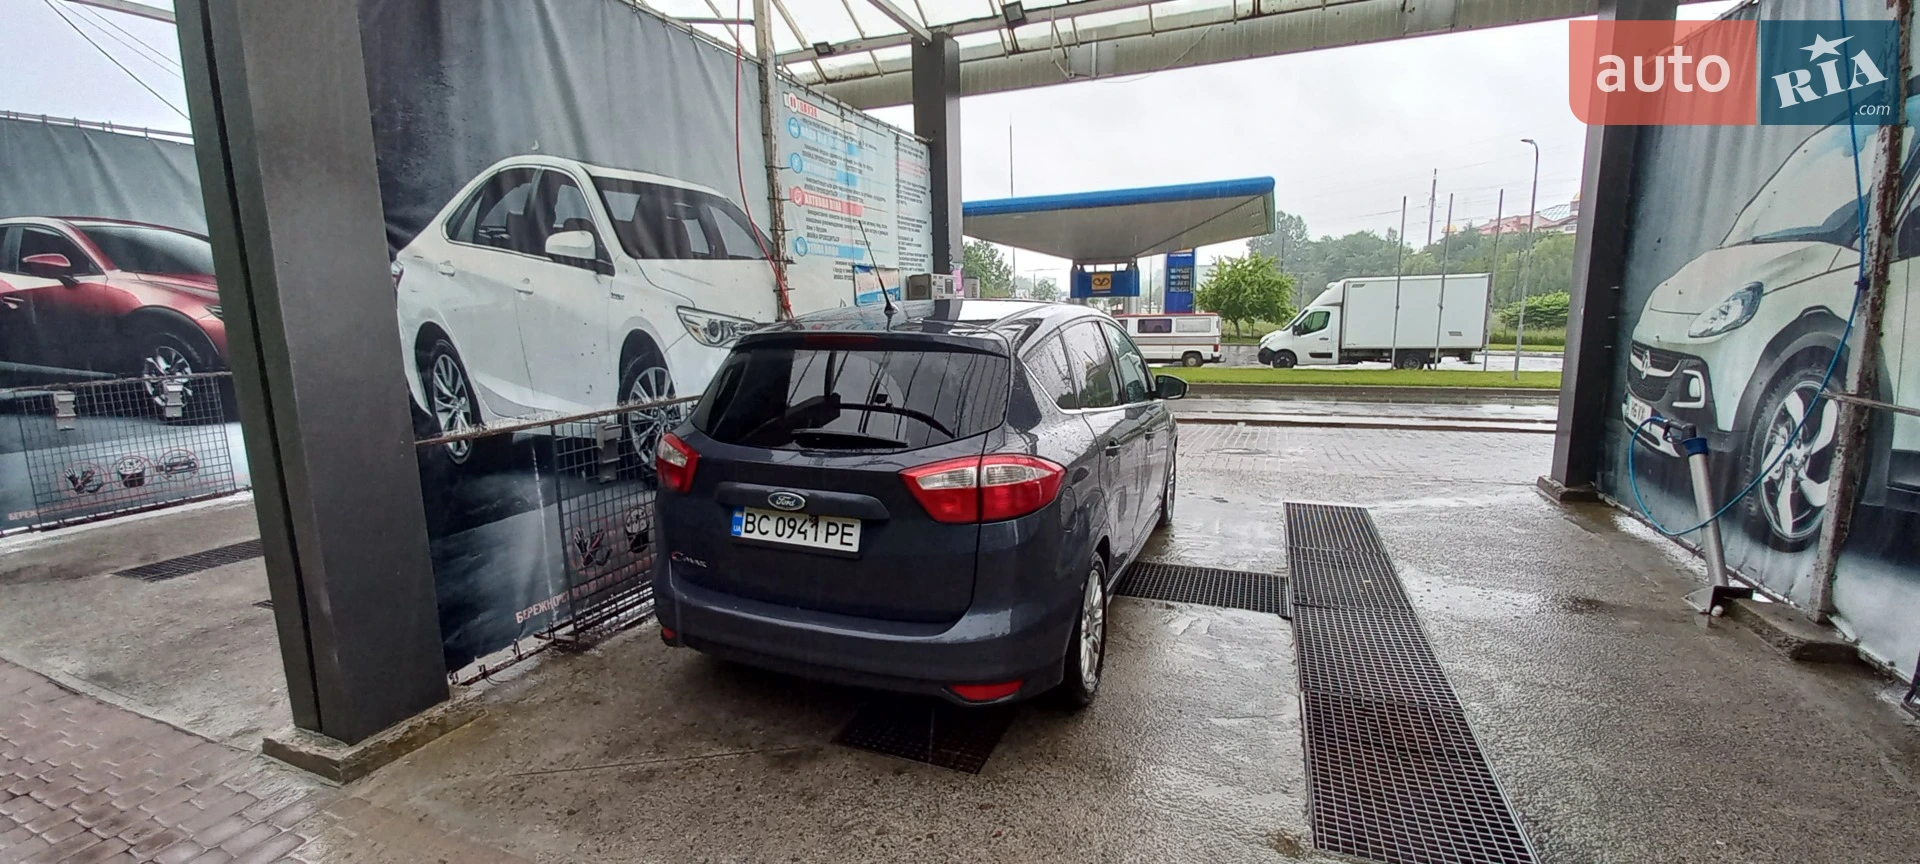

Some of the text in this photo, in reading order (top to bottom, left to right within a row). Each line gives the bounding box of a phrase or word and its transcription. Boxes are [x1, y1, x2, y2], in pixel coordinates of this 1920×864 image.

[775, 495, 796, 507] Ford
[733, 524, 742, 533] UA
[743, 513, 855, 547] BC 0941 PE
